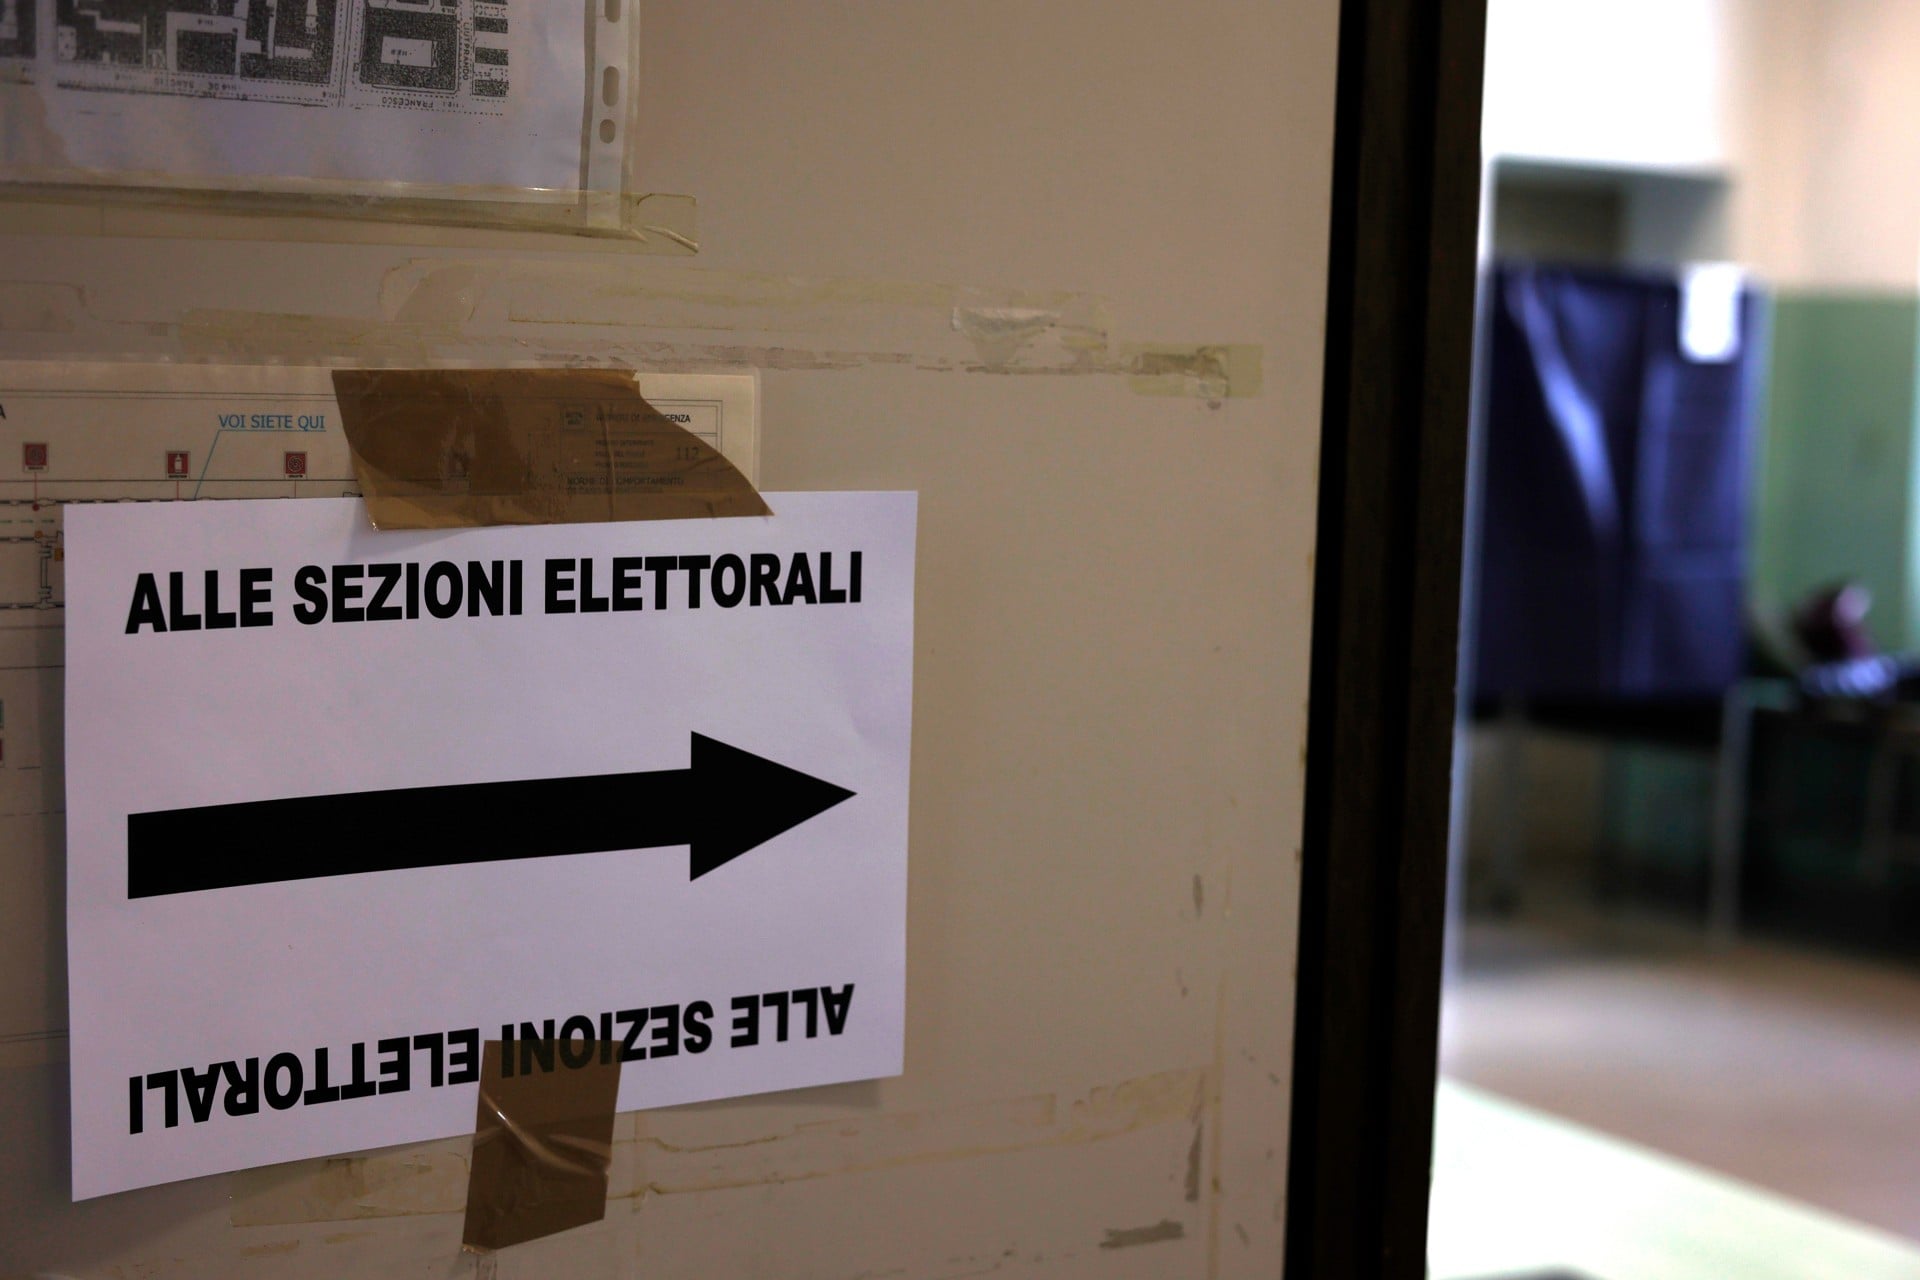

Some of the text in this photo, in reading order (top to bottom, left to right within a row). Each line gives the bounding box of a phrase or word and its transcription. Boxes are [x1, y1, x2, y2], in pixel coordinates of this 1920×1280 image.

[381, 96, 434, 109] FRANCESCO
[218, 415, 326, 432] VOI SIETE QUI
[125, 551, 862, 634] ALLE SEZIONI ELETTORALI
[129, 983, 855, 1135] ALLE SEZIONI ELETTORALI
